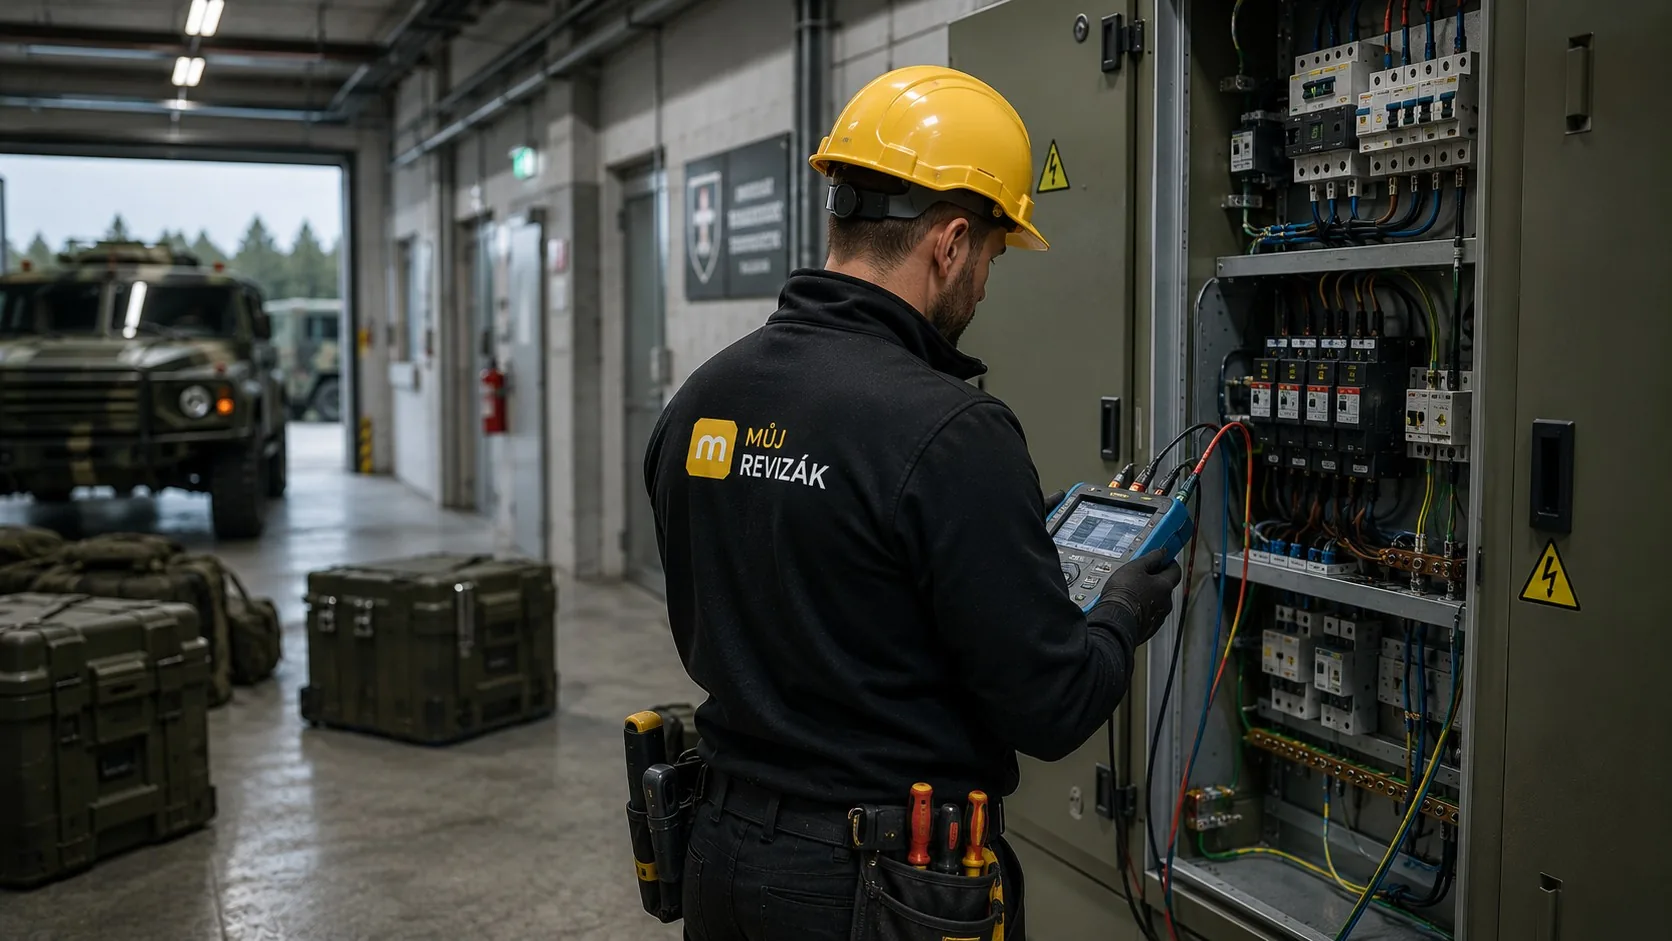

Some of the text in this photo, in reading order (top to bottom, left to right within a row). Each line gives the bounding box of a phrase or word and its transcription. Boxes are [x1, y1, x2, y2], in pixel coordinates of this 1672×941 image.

[695, 434, 727, 462] m
[745, 422, 787, 449] MŮJ
[739, 453, 830, 490] REVIZÁK
